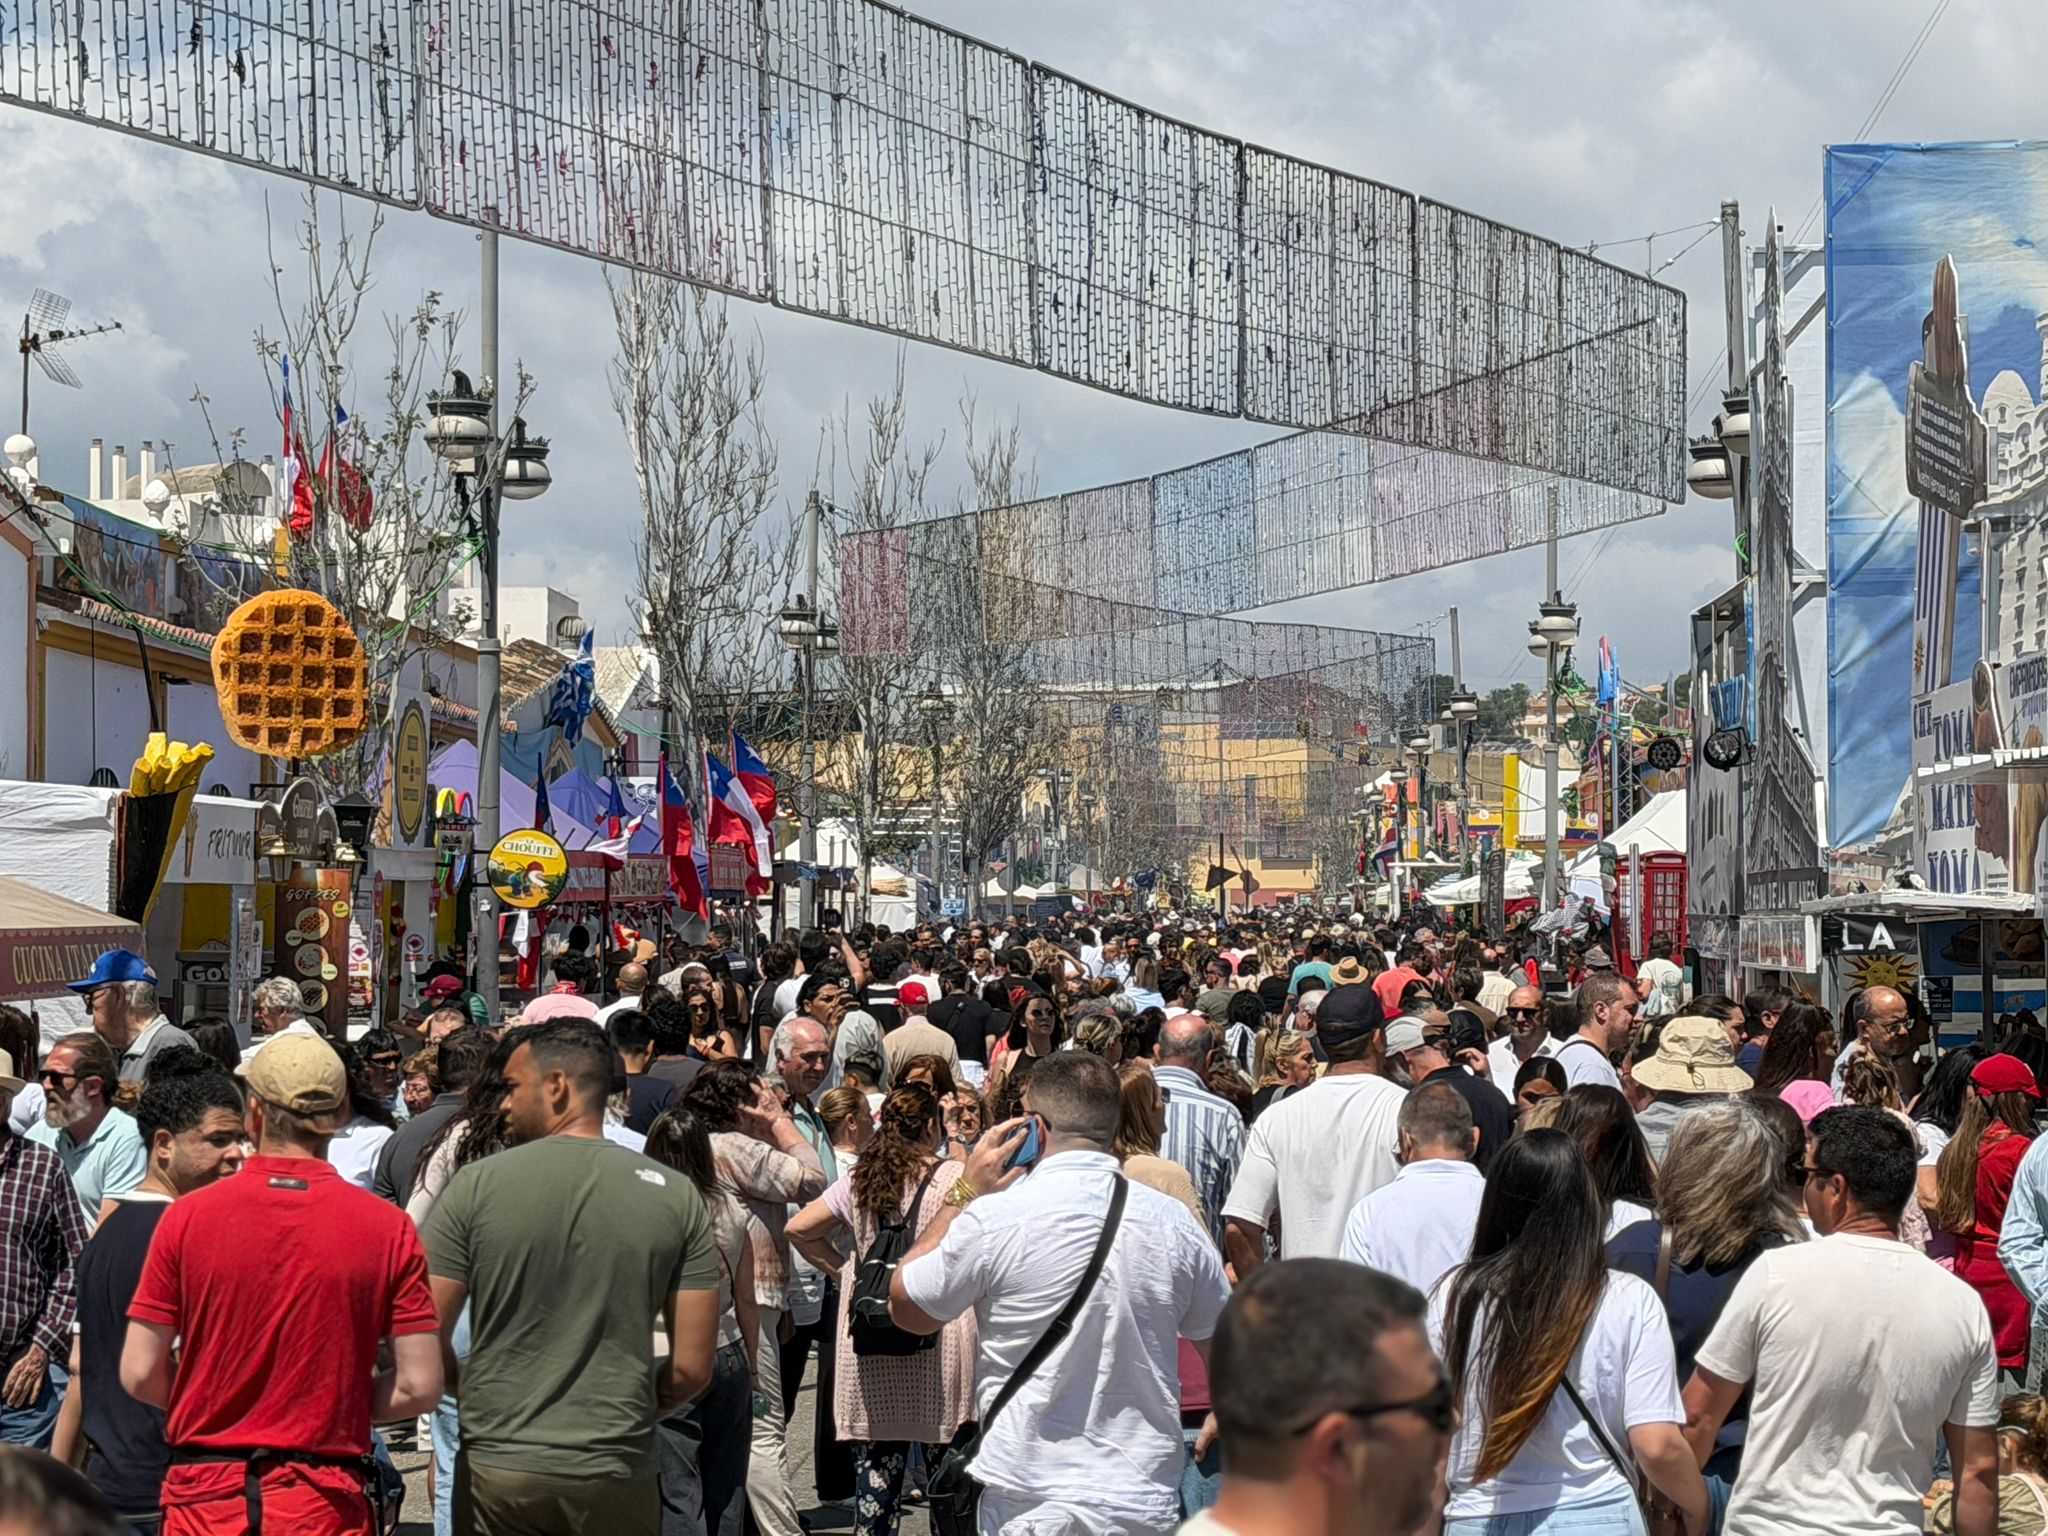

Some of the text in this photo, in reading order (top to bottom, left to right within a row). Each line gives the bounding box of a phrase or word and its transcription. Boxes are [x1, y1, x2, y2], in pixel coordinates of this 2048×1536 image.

[1932, 705, 1975, 762] TOMA
[1931, 784, 1976, 831] MATE
[1843, 922, 1896, 951] LA
[12, 945, 66, 985] CUCINA
